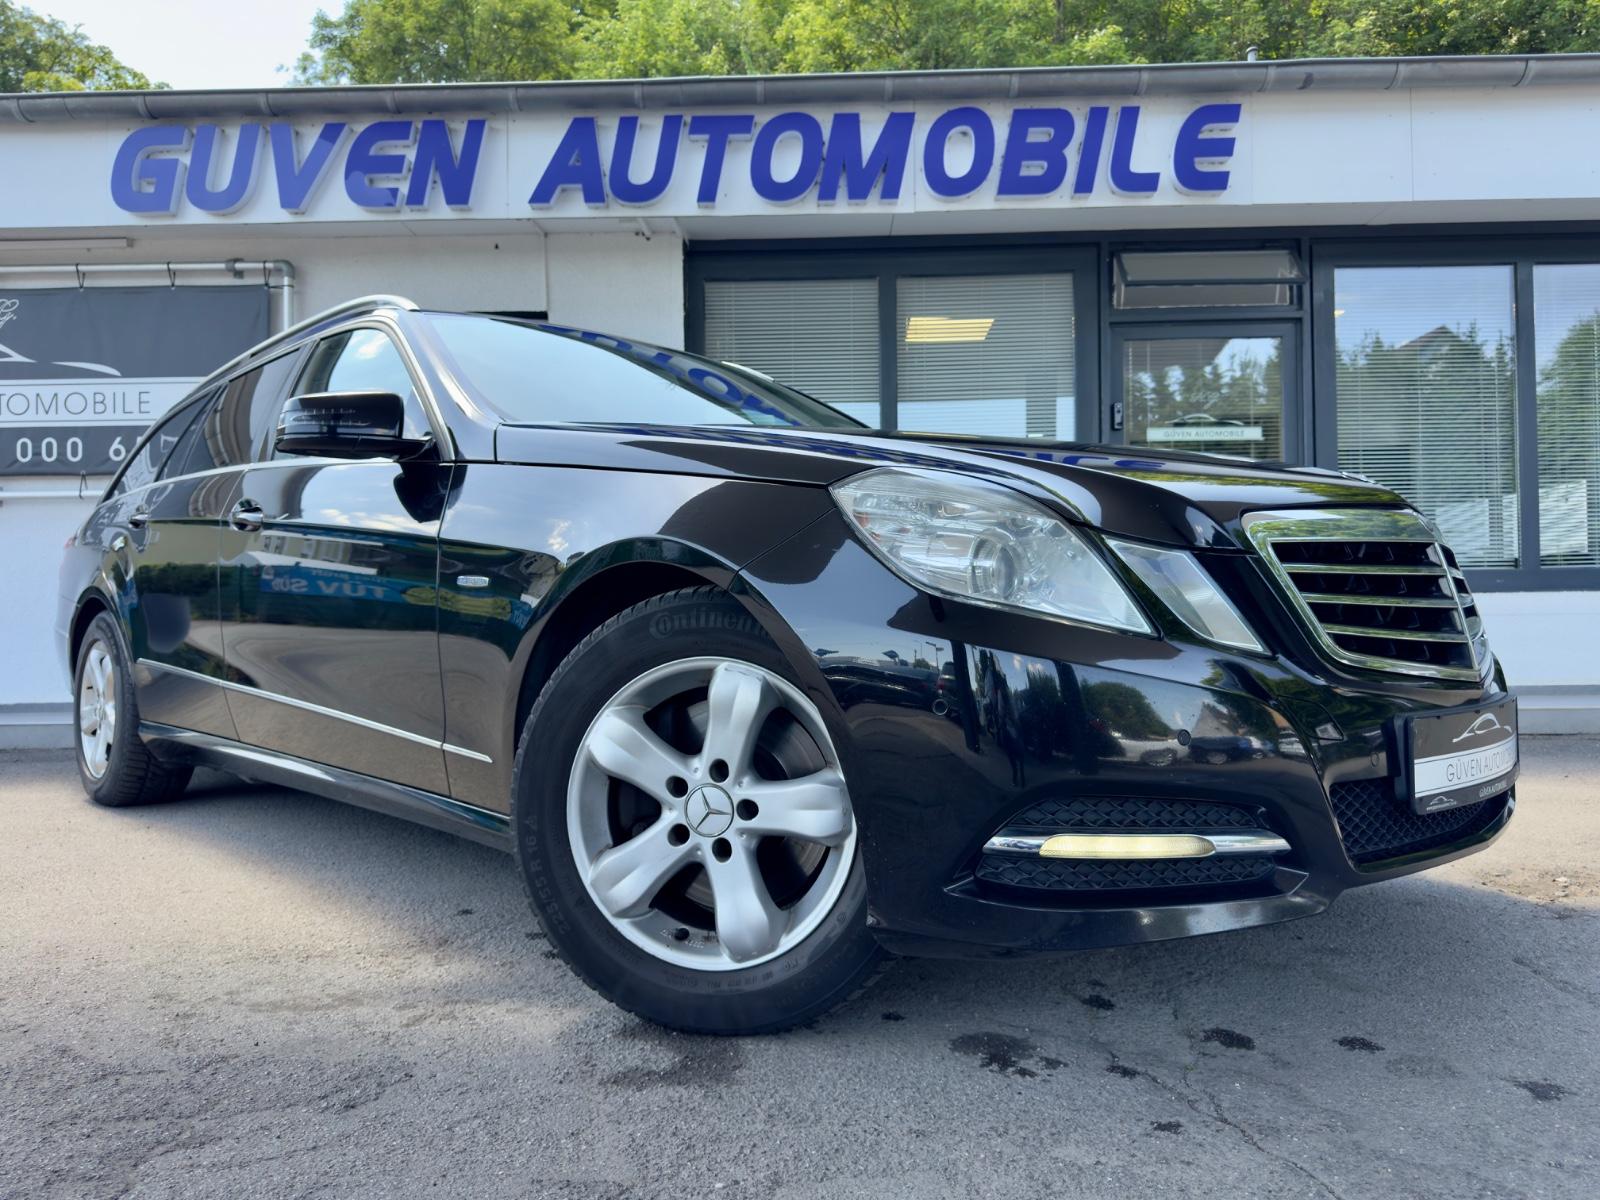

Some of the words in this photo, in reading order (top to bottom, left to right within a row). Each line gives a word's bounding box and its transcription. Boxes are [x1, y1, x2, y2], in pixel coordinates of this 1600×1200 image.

[110, 109, 487, 215] GUVEN
[528, 103, 1243, 208] AUTOMOBILE
[1195, 428, 1245, 438] AUTOMOBILE
[16, 437, 83, 462] 000
[1446, 757, 1482, 782] GÜVEN
